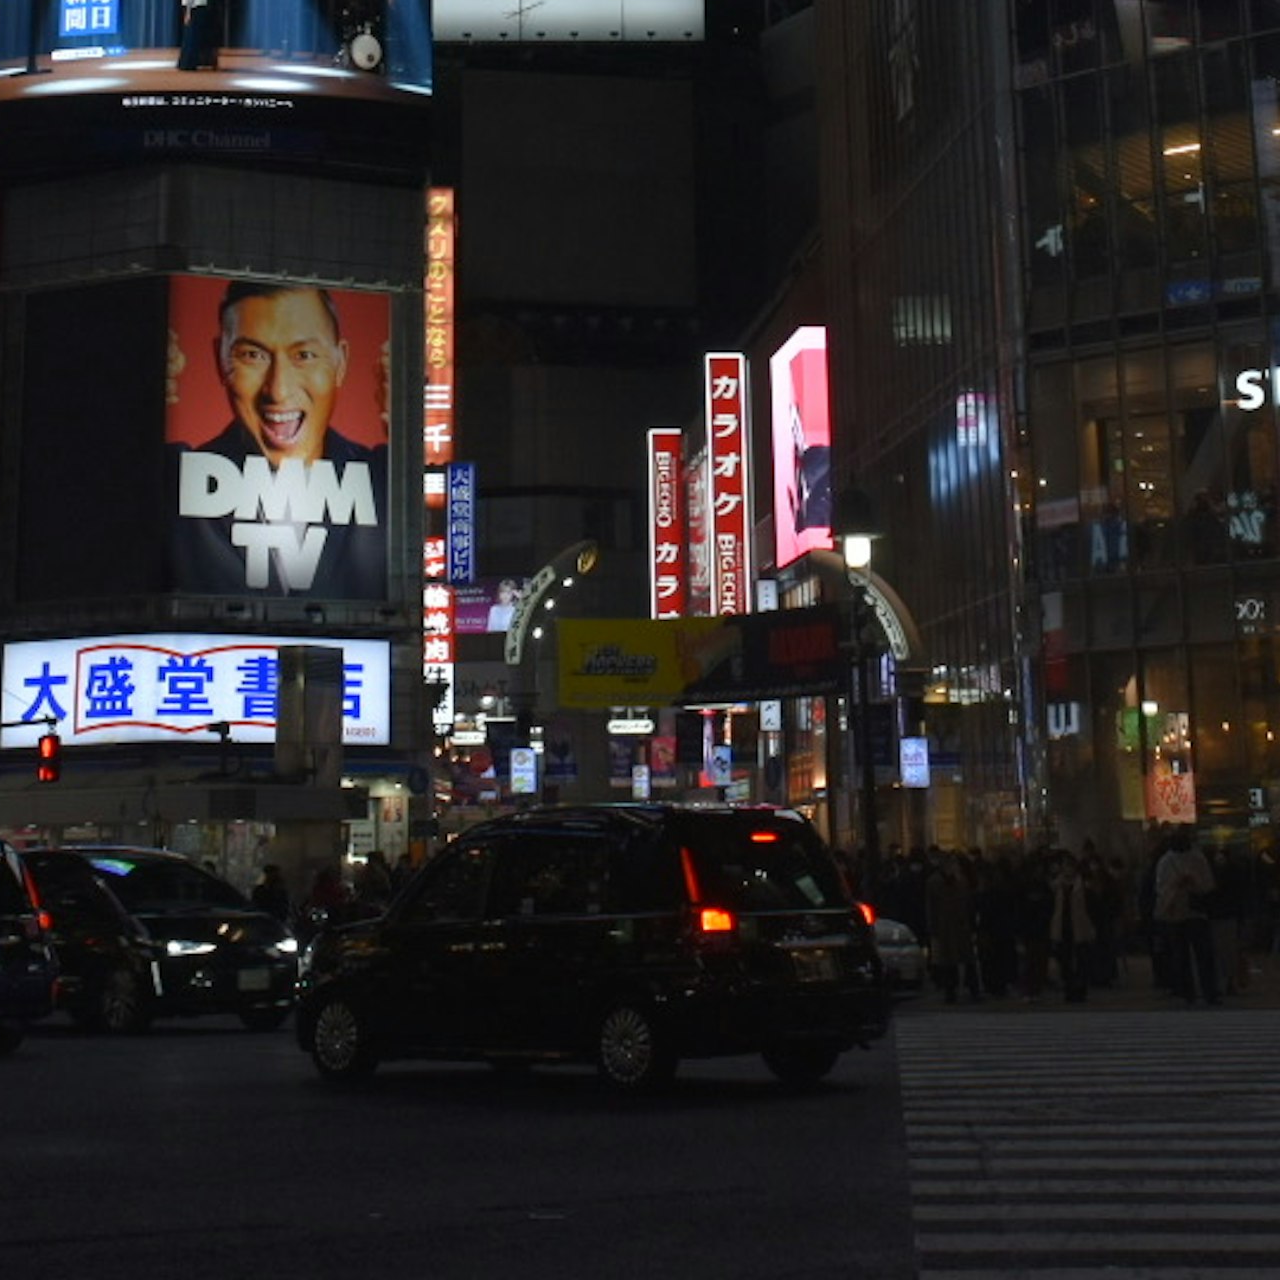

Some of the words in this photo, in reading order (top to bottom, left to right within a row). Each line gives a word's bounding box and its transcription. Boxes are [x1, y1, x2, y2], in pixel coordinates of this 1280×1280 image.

[144, 130, 188, 147] DHC
[191, 129, 271, 148] Channel
[655, 451, 671, 481] BIG
[712, 376, 741, 517] カラオケ
[178, 451, 377, 526] DMM
[656, 484, 672, 528] ECHO
[231, 523, 327, 589] TV
[717, 535, 736, 569] BIG
[655, 543, 679, 619] カラ
